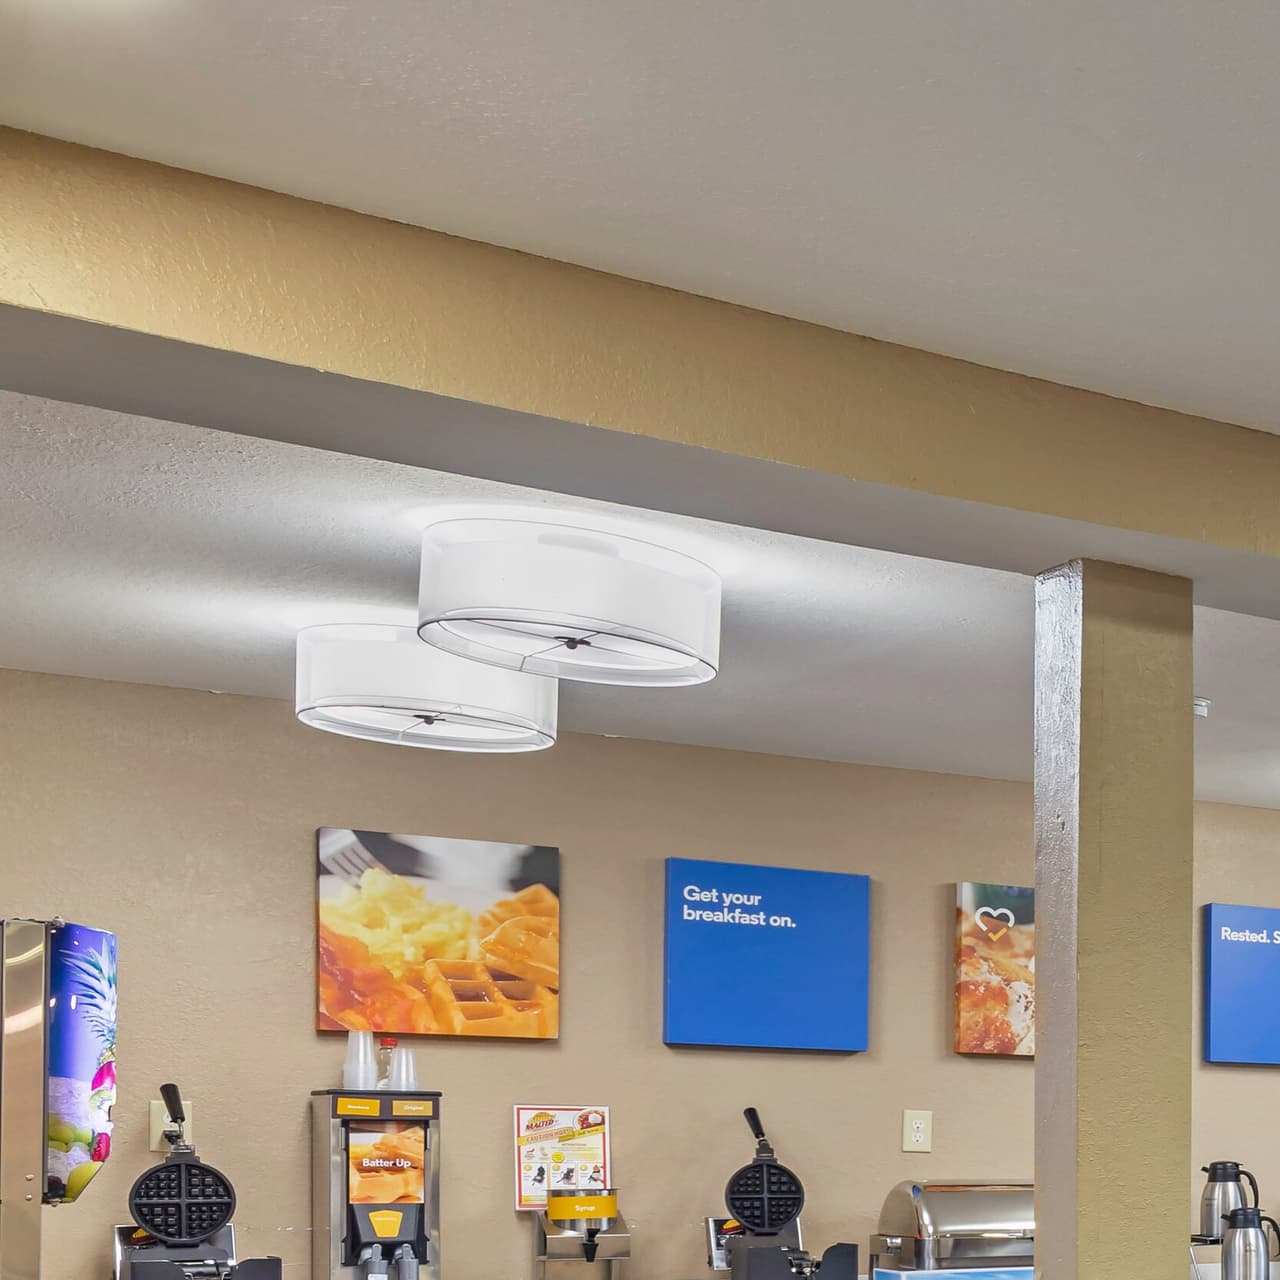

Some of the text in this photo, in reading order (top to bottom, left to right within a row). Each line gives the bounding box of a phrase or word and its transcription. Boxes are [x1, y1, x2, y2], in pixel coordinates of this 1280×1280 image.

[683, 885, 762, 906] Get your
[683, 904, 797, 928] breakfast on.
[1221, 926, 1271, 944] Rested.
[362, 1158, 412, 1169] Batter Up
[575, 1204, 596, 1213] Syrup
